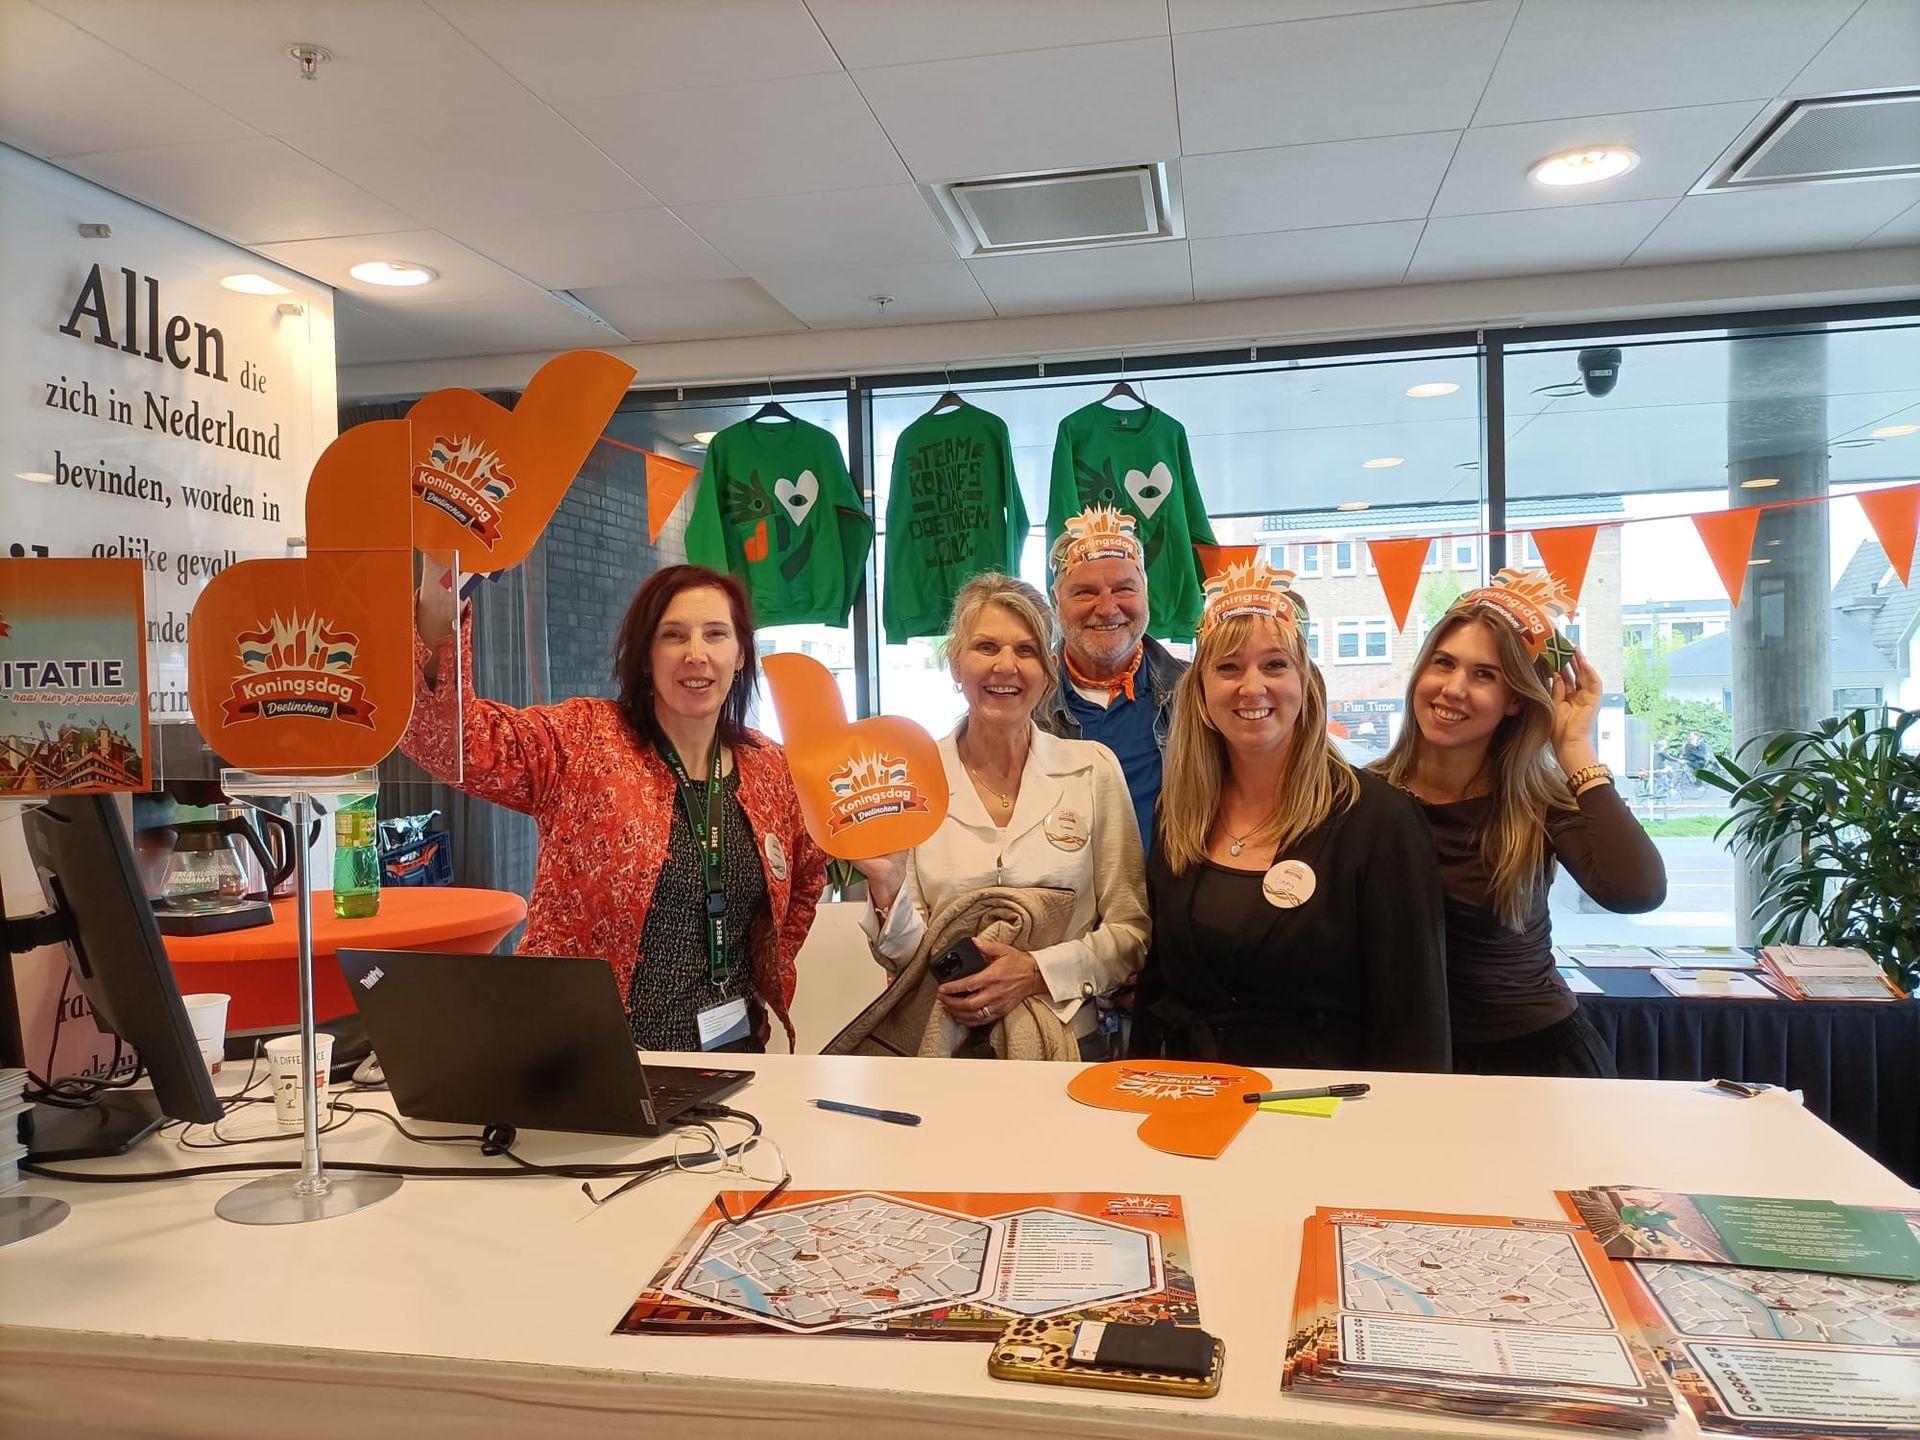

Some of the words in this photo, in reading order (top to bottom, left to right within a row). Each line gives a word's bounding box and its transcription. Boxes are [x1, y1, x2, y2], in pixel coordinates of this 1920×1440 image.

[59, 263, 228, 382] Allen
[240, 360, 267, 394] die
[46, 376, 98, 417] zich
[108, 389, 133, 425] in
[144, 391, 281, 461] Nederland
[918, 436, 972, 470] TEAM
[55, 450, 172, 508] bevinden,
[182, 485, 255, 518] worden
[262, 492, 281, 522] in
[419, 470, 492, 523] Koningsdag
[426, 492, 467, 522] Doetinchem
[1073, 537, 1134, 556] Koningsdag
[1476, 590, 1545, 634] Koningsdag
[3, 660, 124, 688] ITATIE
[242, 677, 353, 703] Koningsdag
[267, 701, 329, 715] Doetinchem
[1344, 702, 1365, 712] Fun
[1367, 701, 1395, 712] Time
[839, 788, 911, 815] Koningsdag
[280, 1051, 325, 1066] DIFFECE
